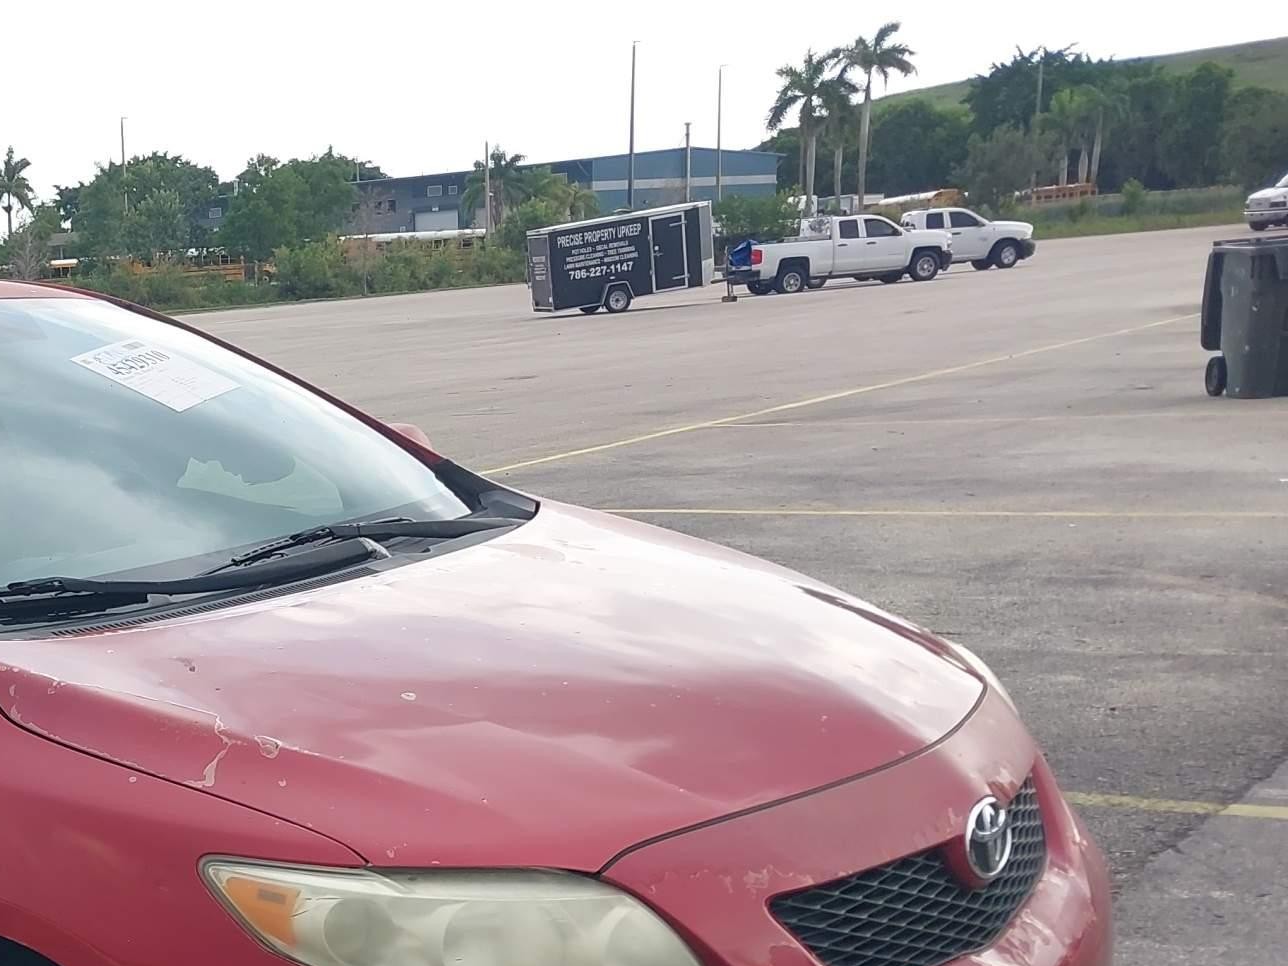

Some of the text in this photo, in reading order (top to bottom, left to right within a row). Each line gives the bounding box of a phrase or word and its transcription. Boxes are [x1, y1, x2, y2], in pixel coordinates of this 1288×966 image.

[557, 223, 642, 248] PRECISE PROPERTY UPKEEP
[569, 261, 634, 280] 786-227-1147
[106, 350, 170, 376] 45429310
